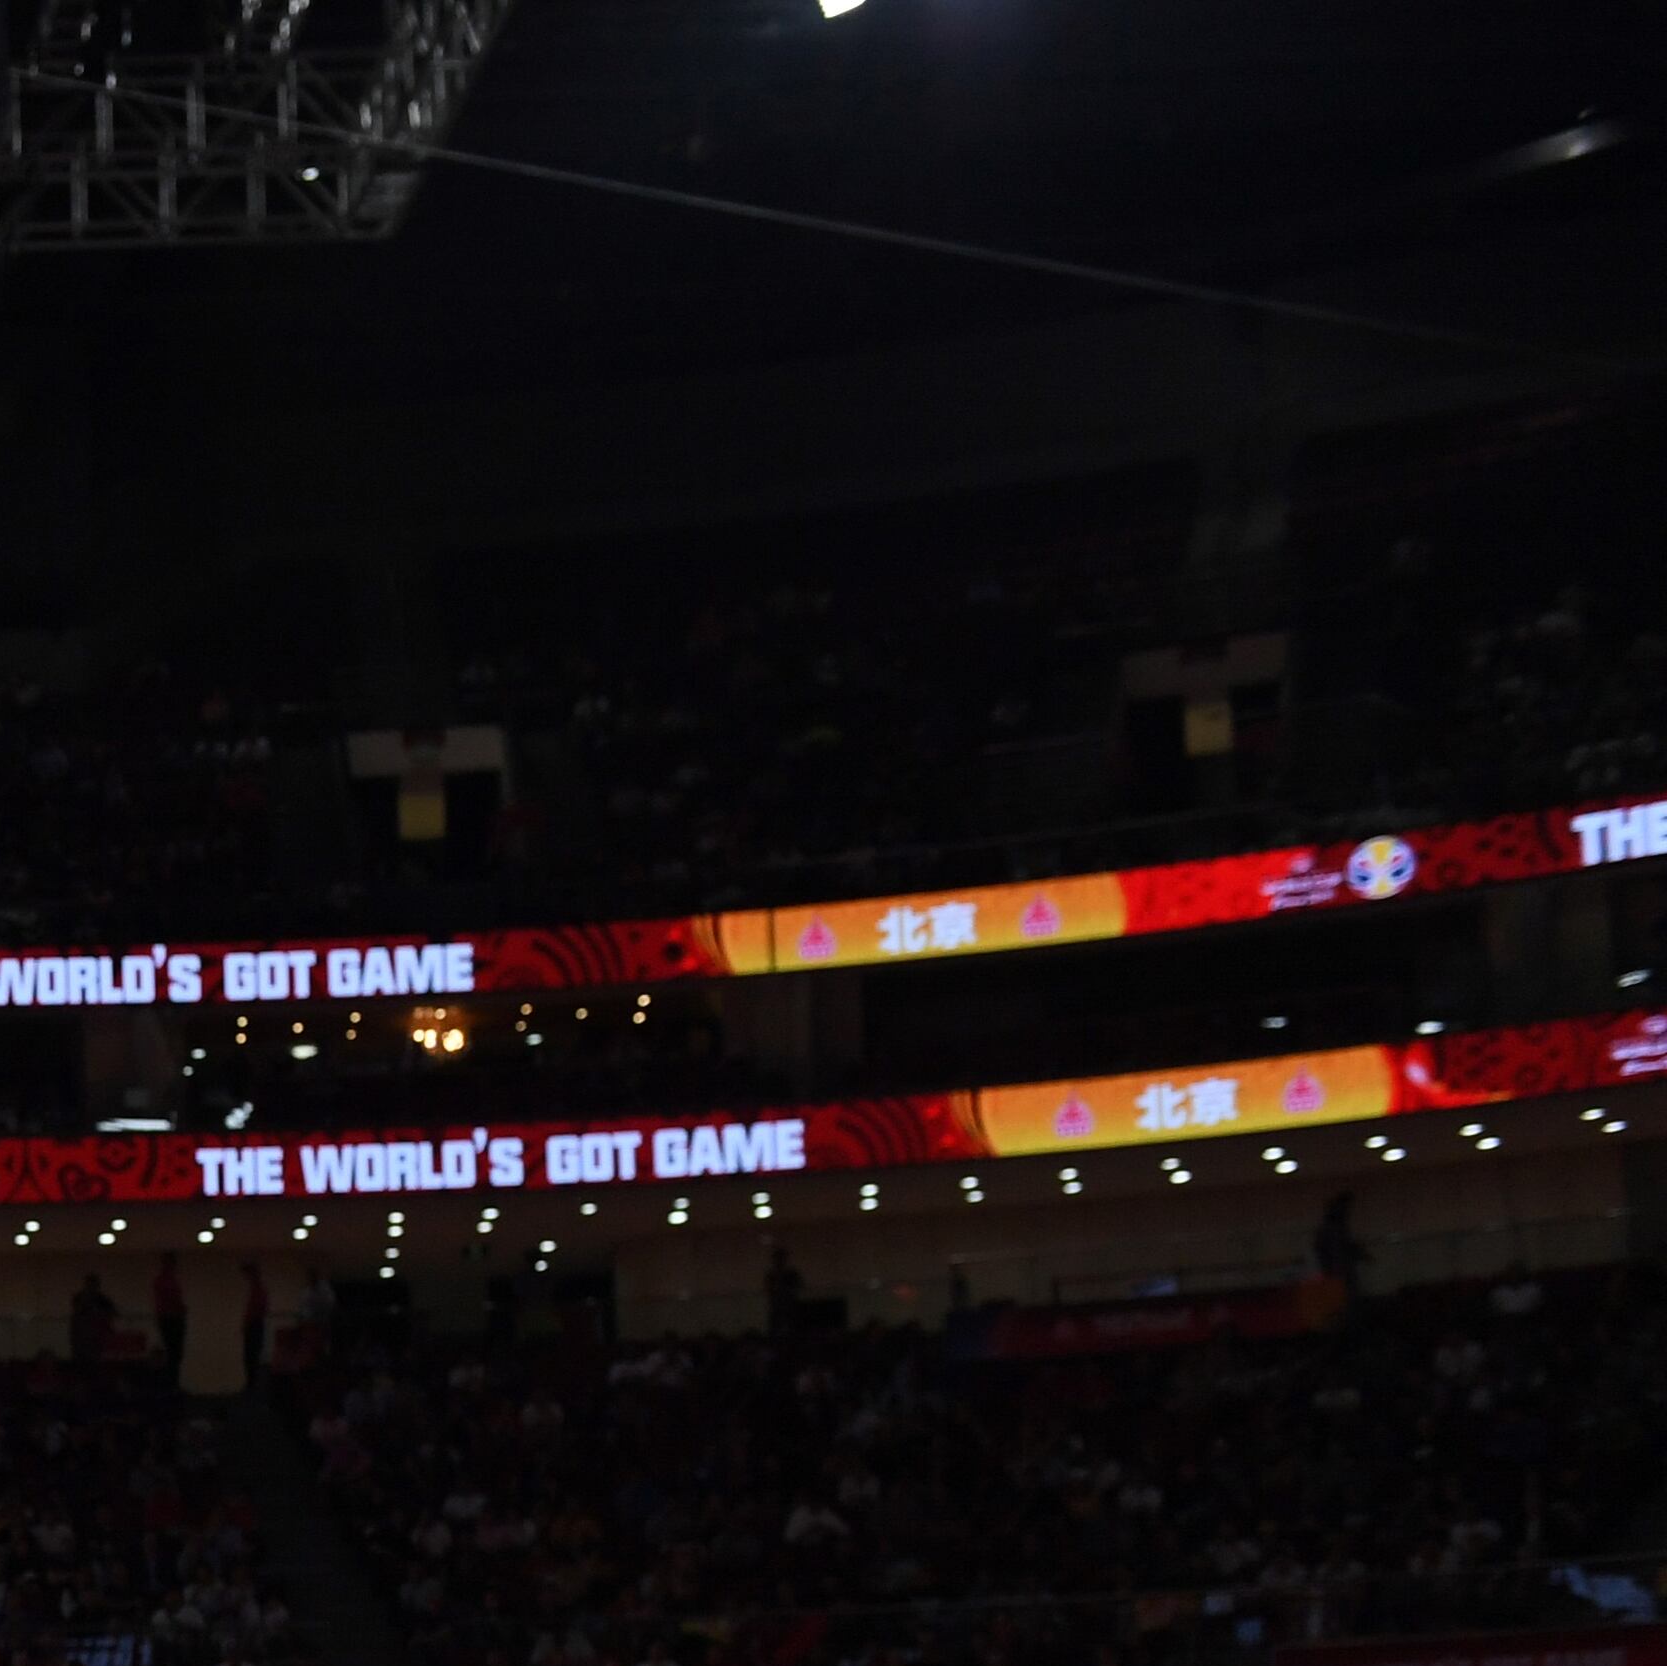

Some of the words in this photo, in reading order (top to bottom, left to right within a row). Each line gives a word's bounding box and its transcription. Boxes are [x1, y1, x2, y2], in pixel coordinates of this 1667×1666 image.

[1570, 799, 1667, 867] THE
[878, 901, 977, 953] 北京
[223, 950, 317, 1001] GOT
[327, 943, 475, 997] GAME
[1136, 1078, 1238, 1131] 北京
[195, 1147, 285, 1196] THE
[300, 1128, 524, 1194] WORLD'S
[546, 1131, 643, 1184] GOT
[653, 1119, 805, 1178] GAME
